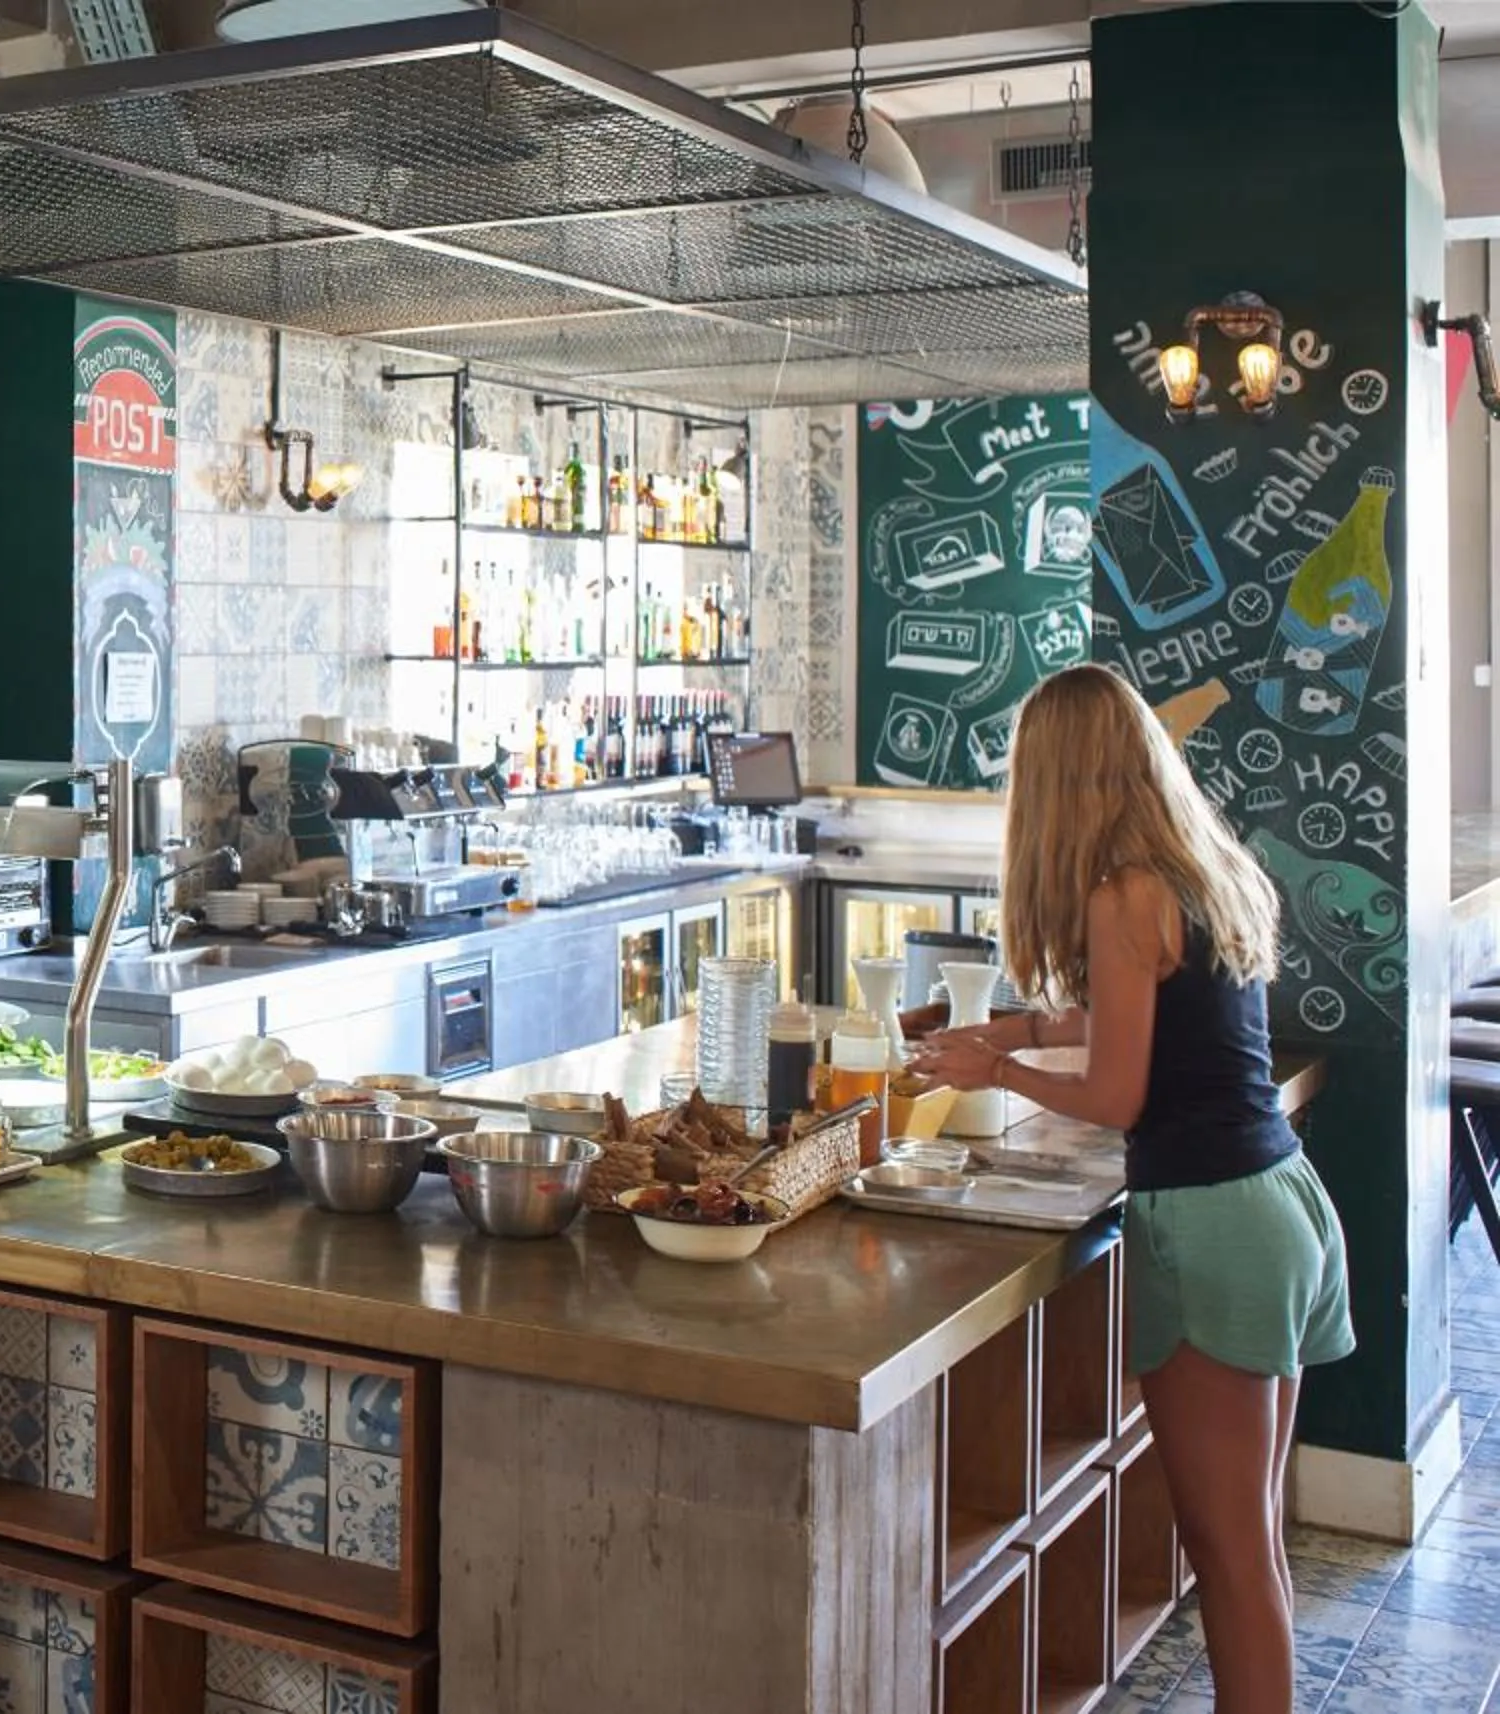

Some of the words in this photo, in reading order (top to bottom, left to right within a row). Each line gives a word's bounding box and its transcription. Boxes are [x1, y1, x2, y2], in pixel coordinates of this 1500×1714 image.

[92, 397, 164, 456] POST
[980, 401, 1051, 458] Meet
[1228, 420, 1360, 560] Fröhlich
[1294, 755, 1396, 862] HAPPY
